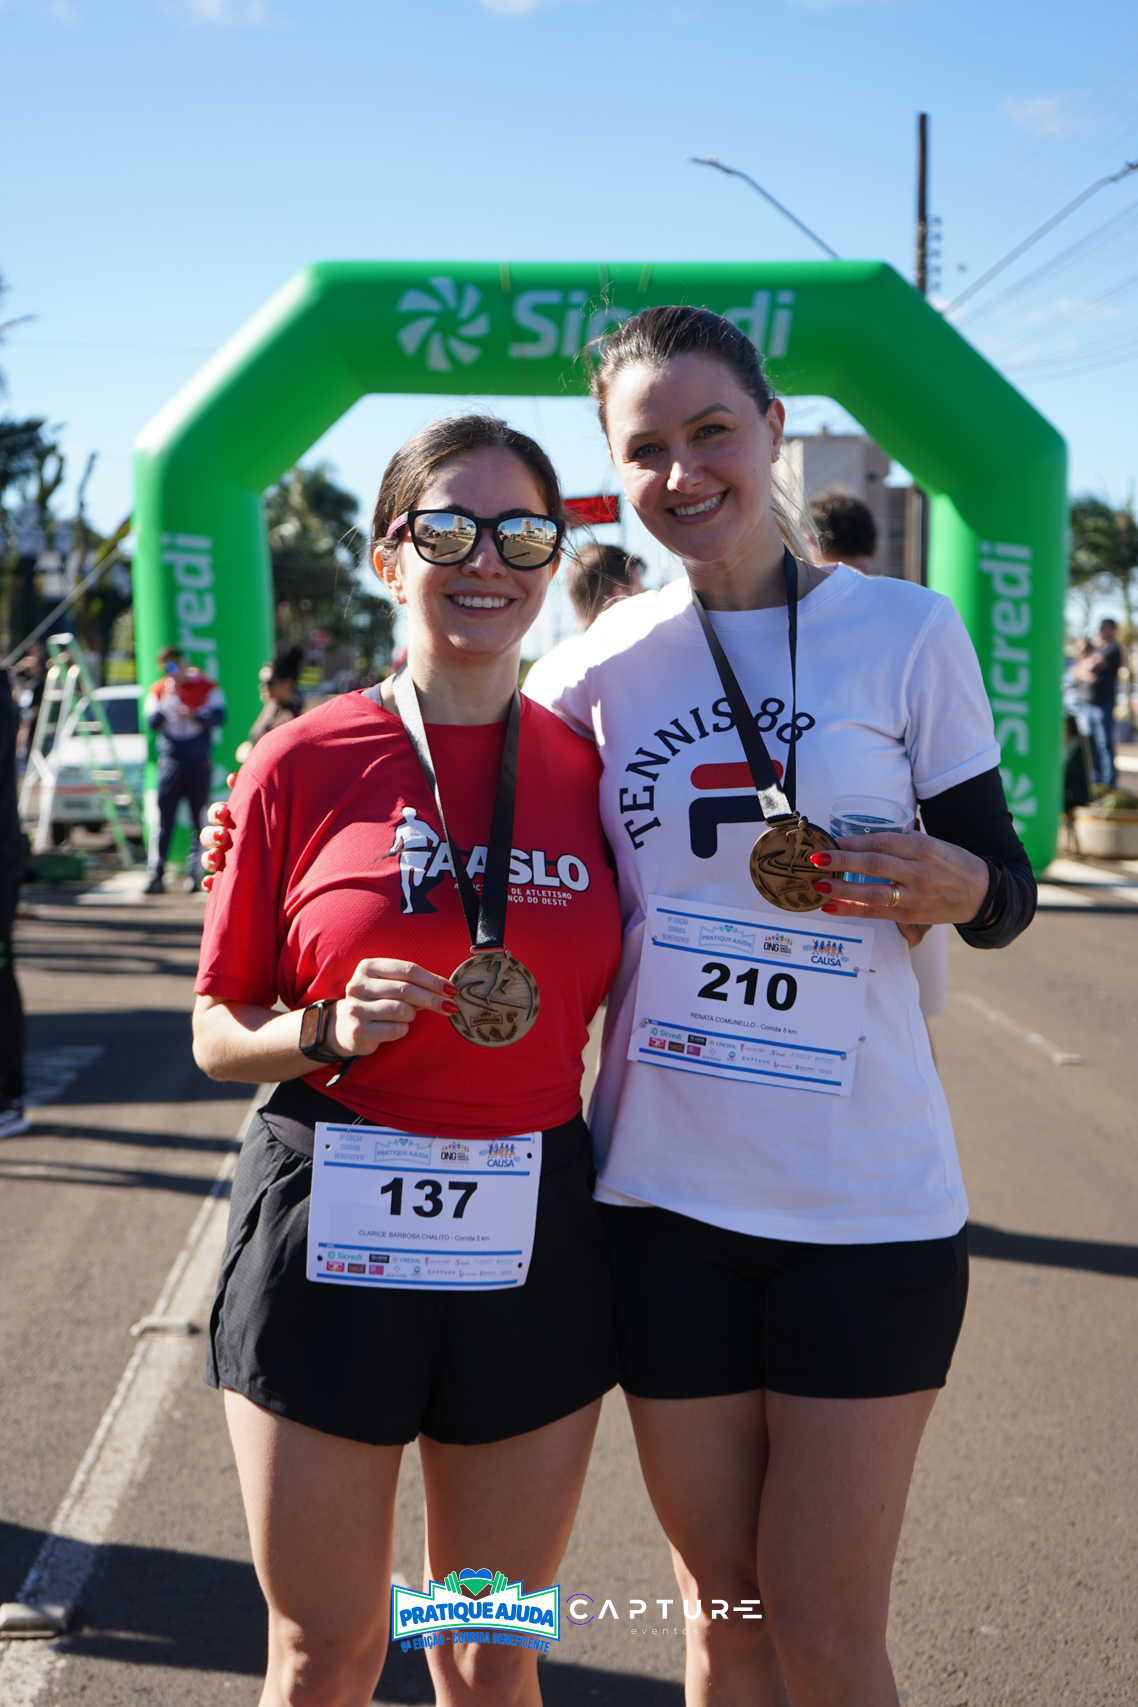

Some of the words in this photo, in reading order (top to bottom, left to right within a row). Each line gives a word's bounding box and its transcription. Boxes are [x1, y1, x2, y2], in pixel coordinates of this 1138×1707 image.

[508, 290, 796, 359] Sicdi
[979, 540, 1033, 755] Sicredi
[619, 698, 737, 850] TENNIS
[526, 889, 572, 900] ATLETISMO
[527, 896, 538, 904] DO
[541, 897, 568, 907] OESTE
[667, 925, 686, 934] CORRIDA
[662, 933, 690, 944] BENEFICENTE
[701, 935, 732, 943] PRATIQUE
[732, 938, 752, 948] AJUDA
[763, 942, 779, 952] ONG
[810, 955, 842, 967] CAUSA
[697, 962, 798, 1011] 210
[690, 1012, 714, 1022] RENATA
[715, 1017, 756, 1028] COMUNELLO
[760, 1023, 782, 1033] Corrida
[659, 1029, 683, 1040] Sicredi
[715, 1041, 737, 1049] CRESOL
[334, 1152, 365, 1161] BENEFICENTE
[377, 1149, 408, 1157] PRATIQUE
[408, 1151, 429, 1159] AJUDA
[441, 1151, 457, 1160] ONG
[487, 1159, 515, 1168] CAUSA
[380, 1177, 478, 1219] 137
[359, 1229, 387, 1238] CLARICE
[388, 1231, 420, 1239] BARBOSA
[421, 1233, 450, 1241] CHALITO
[337, 1251, 363, 1261] Sicredi
